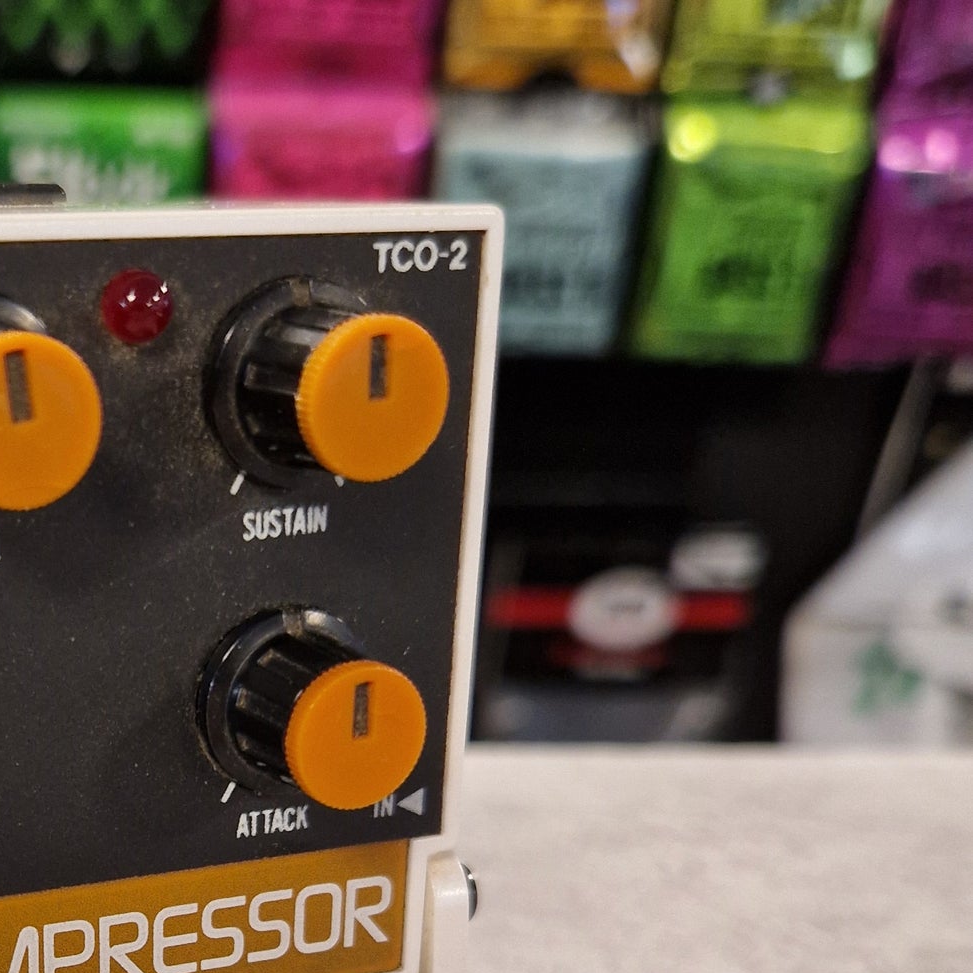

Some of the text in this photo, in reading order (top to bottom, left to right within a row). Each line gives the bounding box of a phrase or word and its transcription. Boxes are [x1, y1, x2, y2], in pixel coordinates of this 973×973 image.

[372, 239, 468, 273] TCO-2
[242, 504, 328, 541] SUSTAIN
[236, 804, 309, 838] ATTACK
